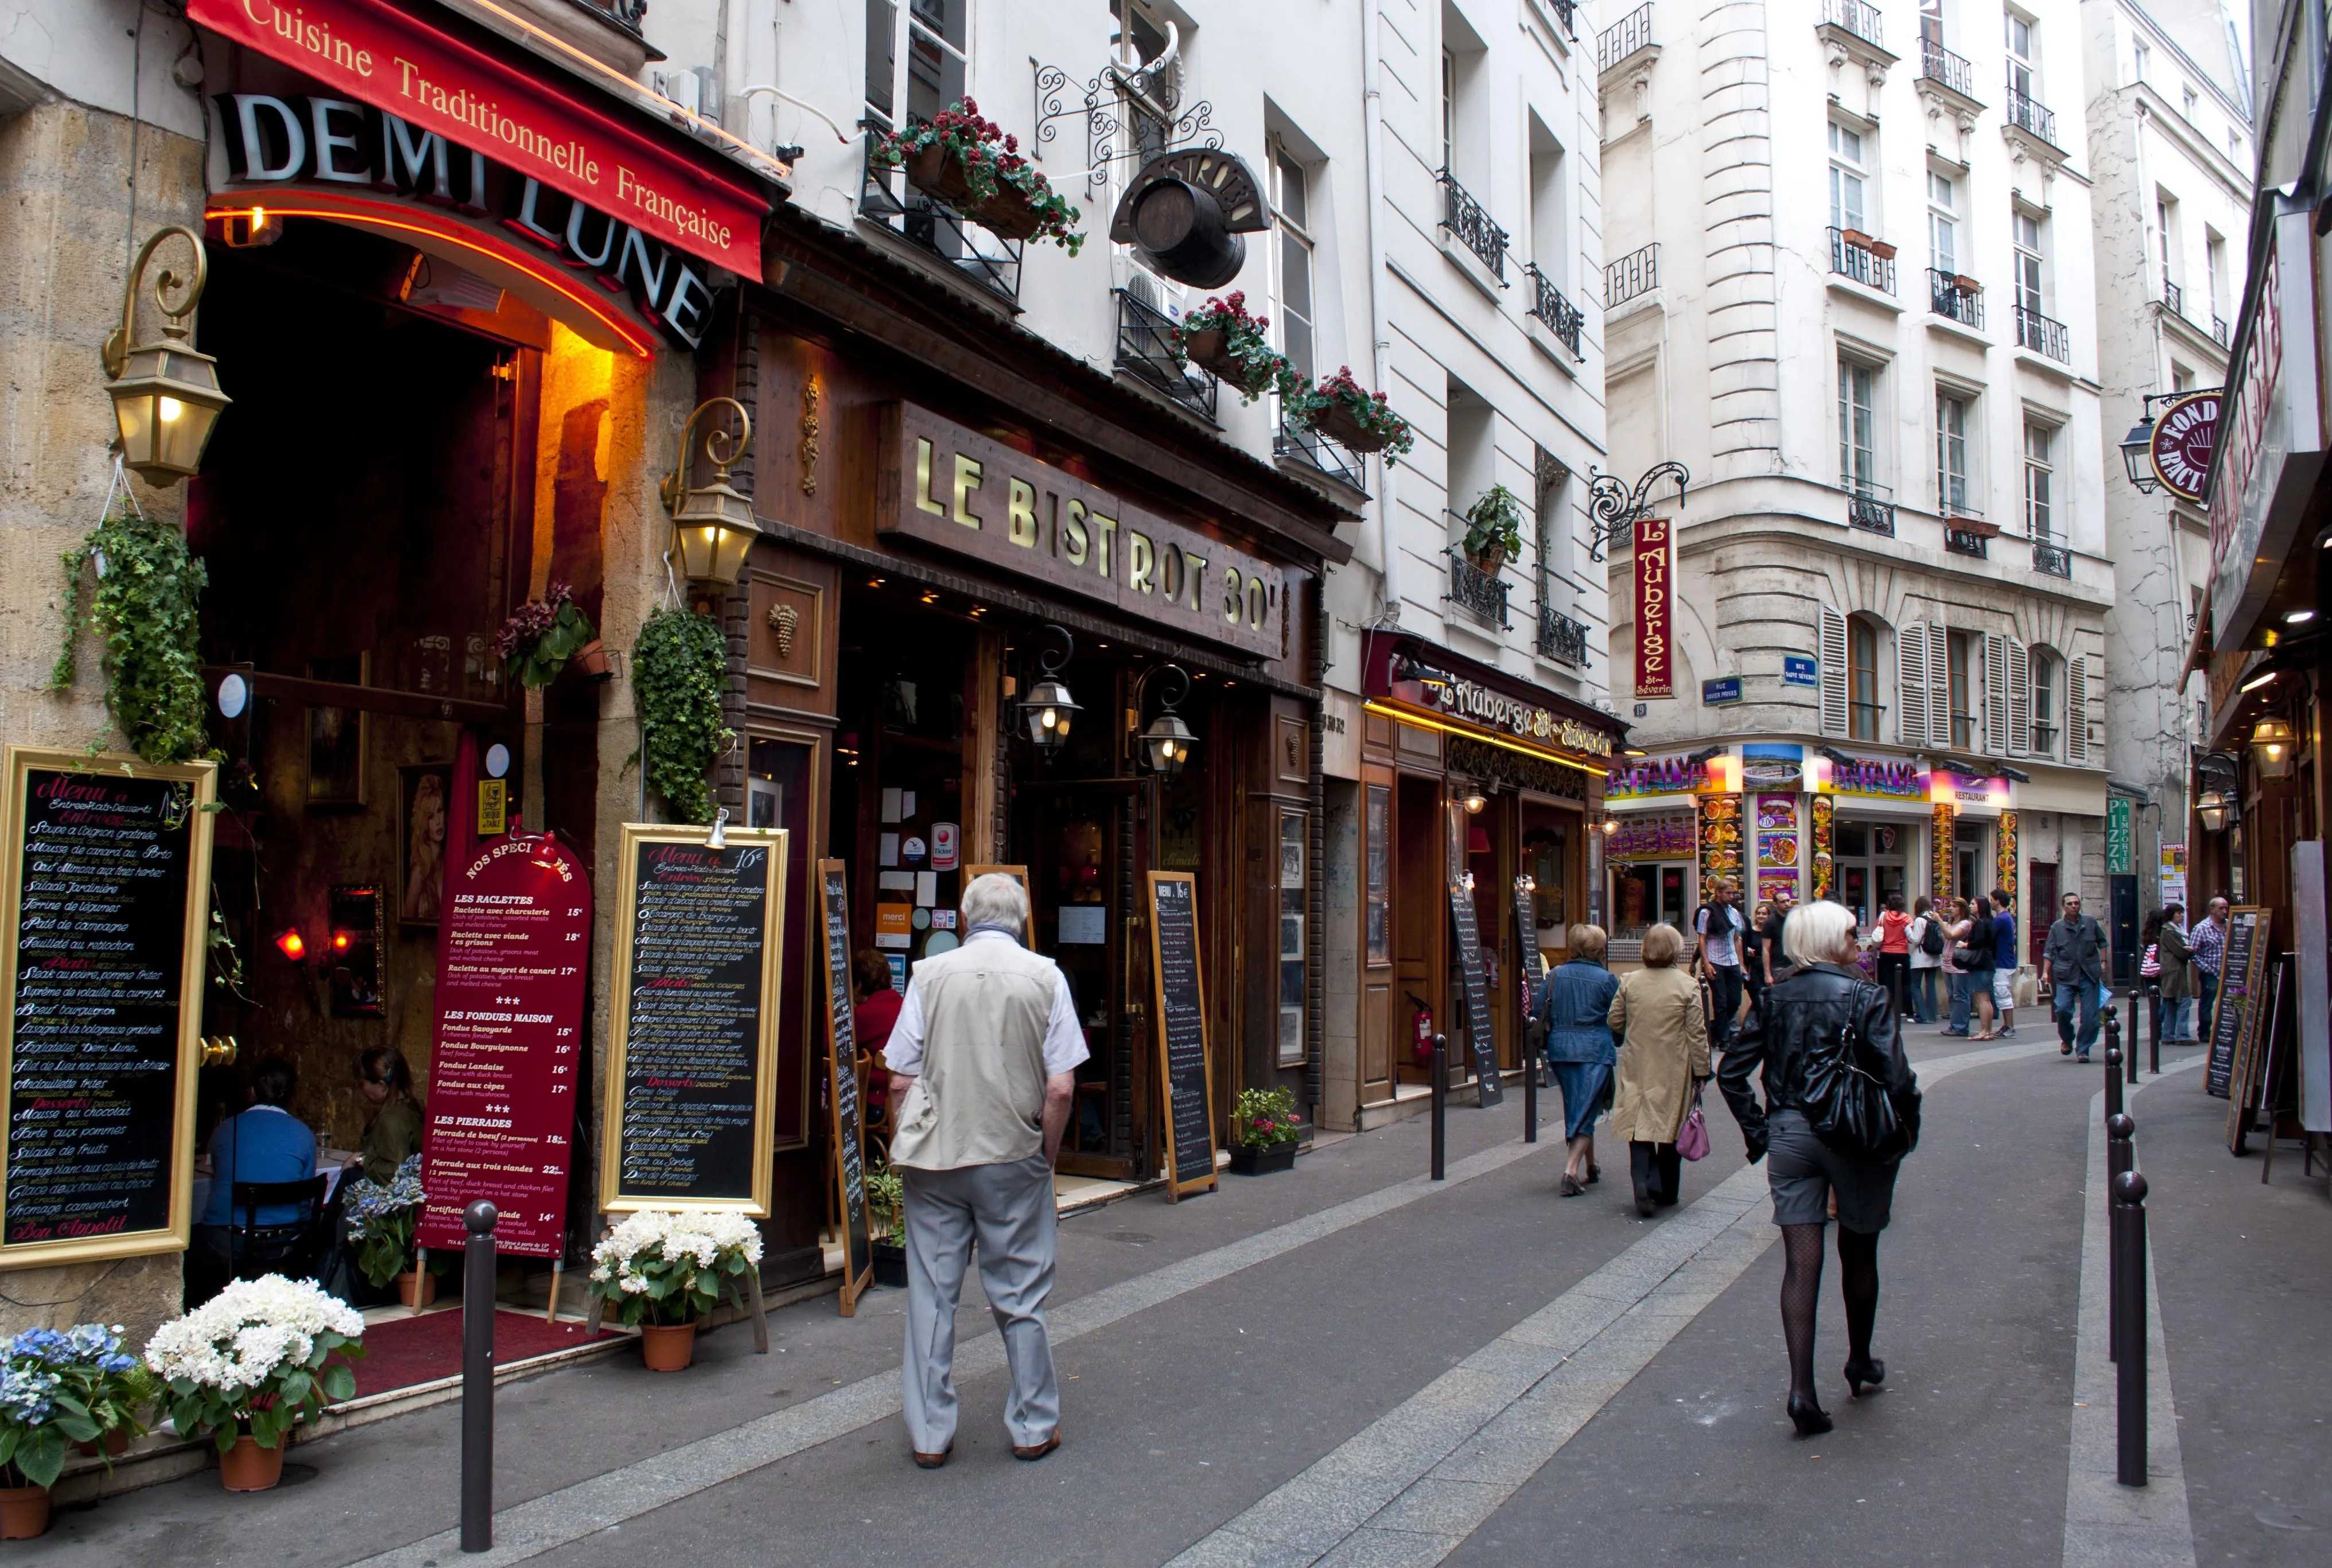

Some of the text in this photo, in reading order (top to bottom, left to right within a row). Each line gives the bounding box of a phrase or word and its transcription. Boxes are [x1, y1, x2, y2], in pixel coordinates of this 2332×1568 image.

[244, 0, 731, 250] Cuisine Traditionnelle Française
[231, 93, 716, 350] DEMI LUNE
[2159, 450, 2206, 493] RACL
[916, 435, 983, 531] LE
[1009, 475, 1208, 613] BISTROT
[1638, 522, 1666, 674] L'Auberge
[1636, 685, 1672, 695] Séverin
[1721, 690, 1738, 698] PRIVAS
[1636, 705, 1645, 716] 19
[1562, 718, 1612, 759] Séverin
[36, 777, 107, 801] Menu
[1955, 791, 1989, 803] RESTAURANT
[29, 820, 66, 835] Soupe
[2108, 800, 2121, 872] PIZZA
[25, 842, 173, 859] Mousse de canard au Porto
[648, 845, 704, 865] Menu
[466, 854, 491, 880] NOS
[24, 881, 67, 892] Salade
[1157, 885, 1171, 897] MENU
[21, 898, 61, 911] Terrine
[64, 901, 77, 911] de
[454, 894, 534, 905] LES RACLETTES
[453, 906, 484, 915] Raclette
[505, 908, 550, 916] charcuterie
[883, 912, 905, 921] merci
[57, 919, 71, 930] de
[75, 922, 130, 933] campagne
[451, 931, 483, 939] Raclette
[503, 932, 529, 940] viande
[70, 941, 85, 950] au
[87, 940, 135, 951] reblochon
[465, 939, 493, 947] grisons
[448, 964, 478, 972] Raclette
[491, 966, 517, 974] magret
[444, 1010, 553, 1024] LES FONDUES MAISON
[442, 1024, 471, 1032] Fondue
[472, 1025, 512, 1034] Savoyarde
[470, 1042, 528, 1052] Bourguignonne
[438, 1061, 467, 1069] Fondue
[468, 1063, 504, 1071] Landaise
[437, 1080, 465, 1088] Fondue
[483, 1082, 505, 1091] cèpes
[13, 1106, 132, 1122] Mousse au chocolat
[434, 1115, 512, 1128] LES PIERRADES
[11, 1126, 127, 1141] Tarte aux pommes
[433, 1129, 465, 1138] Pierrade
[467, 1131, 477, 1139] de
[478, 1131, 502, 1141] boeuf
[9, 1143, 109, 1160] Salade de fruits
[432, 1159, 464, 1168] Pierrade
[483, 1162, 501, 1170] trois
[503, 1164, 534, 1173] viandes
[6, 1197, 129, 1218] Fromage camembert
[498, 1211, 521, 1219] alade
[12, 1221, 52, 1240] Bon
